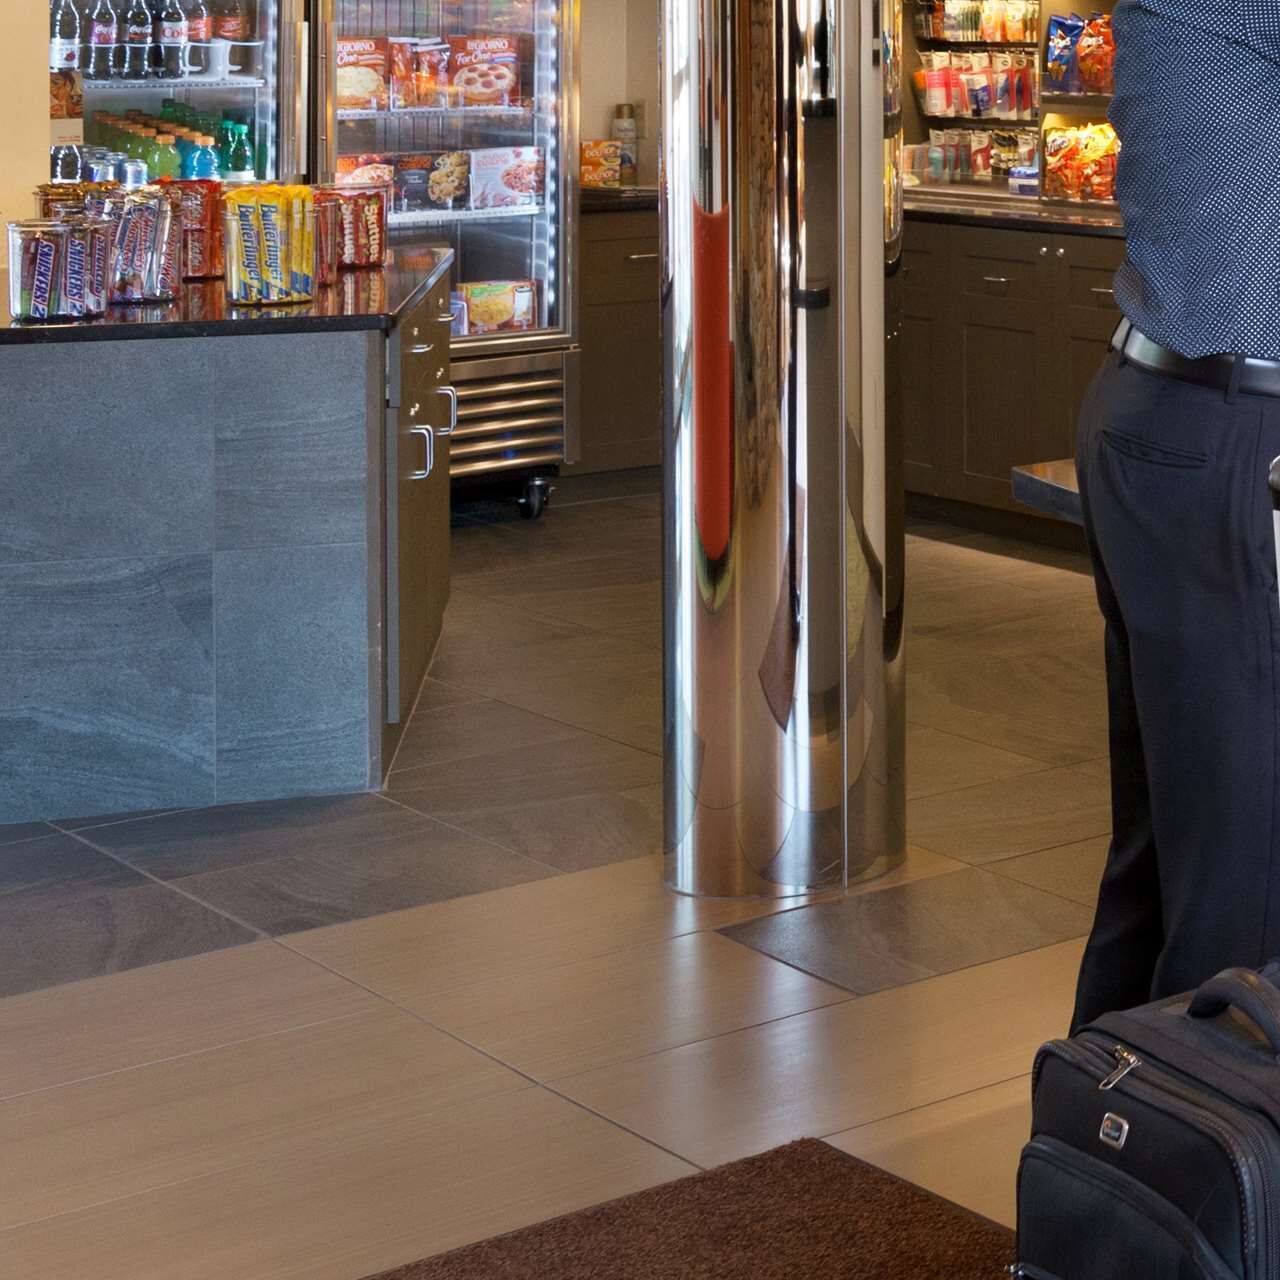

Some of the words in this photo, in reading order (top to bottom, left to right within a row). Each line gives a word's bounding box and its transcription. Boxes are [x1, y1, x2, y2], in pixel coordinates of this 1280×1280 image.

[33, 241, 54, 302] SNICKERS
[68, 239, 85, 299] SNICKERS
[238, 204, 260, 282] Butterfinger
[260, 204, 283, 282] Butterfinger
